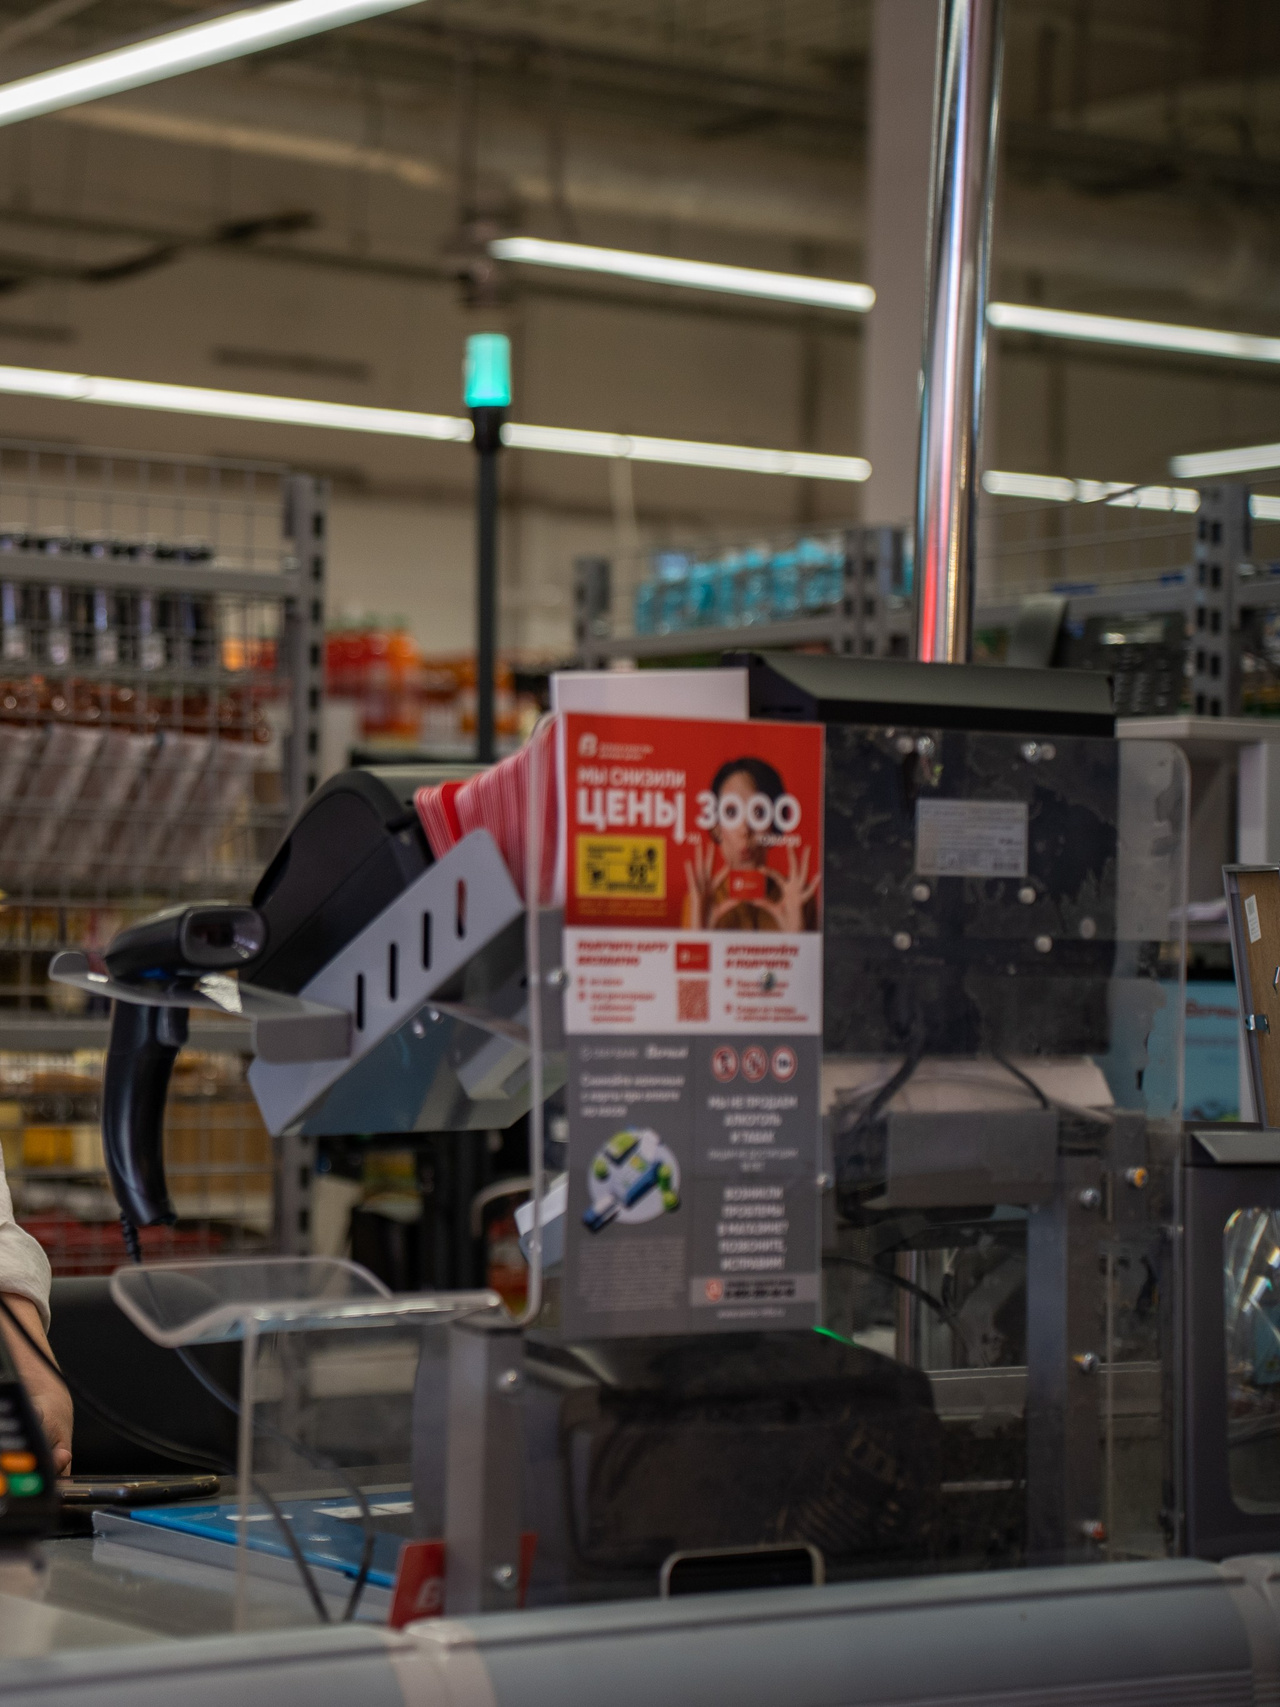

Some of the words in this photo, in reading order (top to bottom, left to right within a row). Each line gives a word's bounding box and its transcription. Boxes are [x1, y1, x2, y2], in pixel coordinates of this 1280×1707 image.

[577, 767, 608, 786] МЫ
[609, 767, 686, 789] СНИЗИЛИ
[577, 788, 686, 842] ЦЕНЫ
[696, 790, 801, 832] 3000
